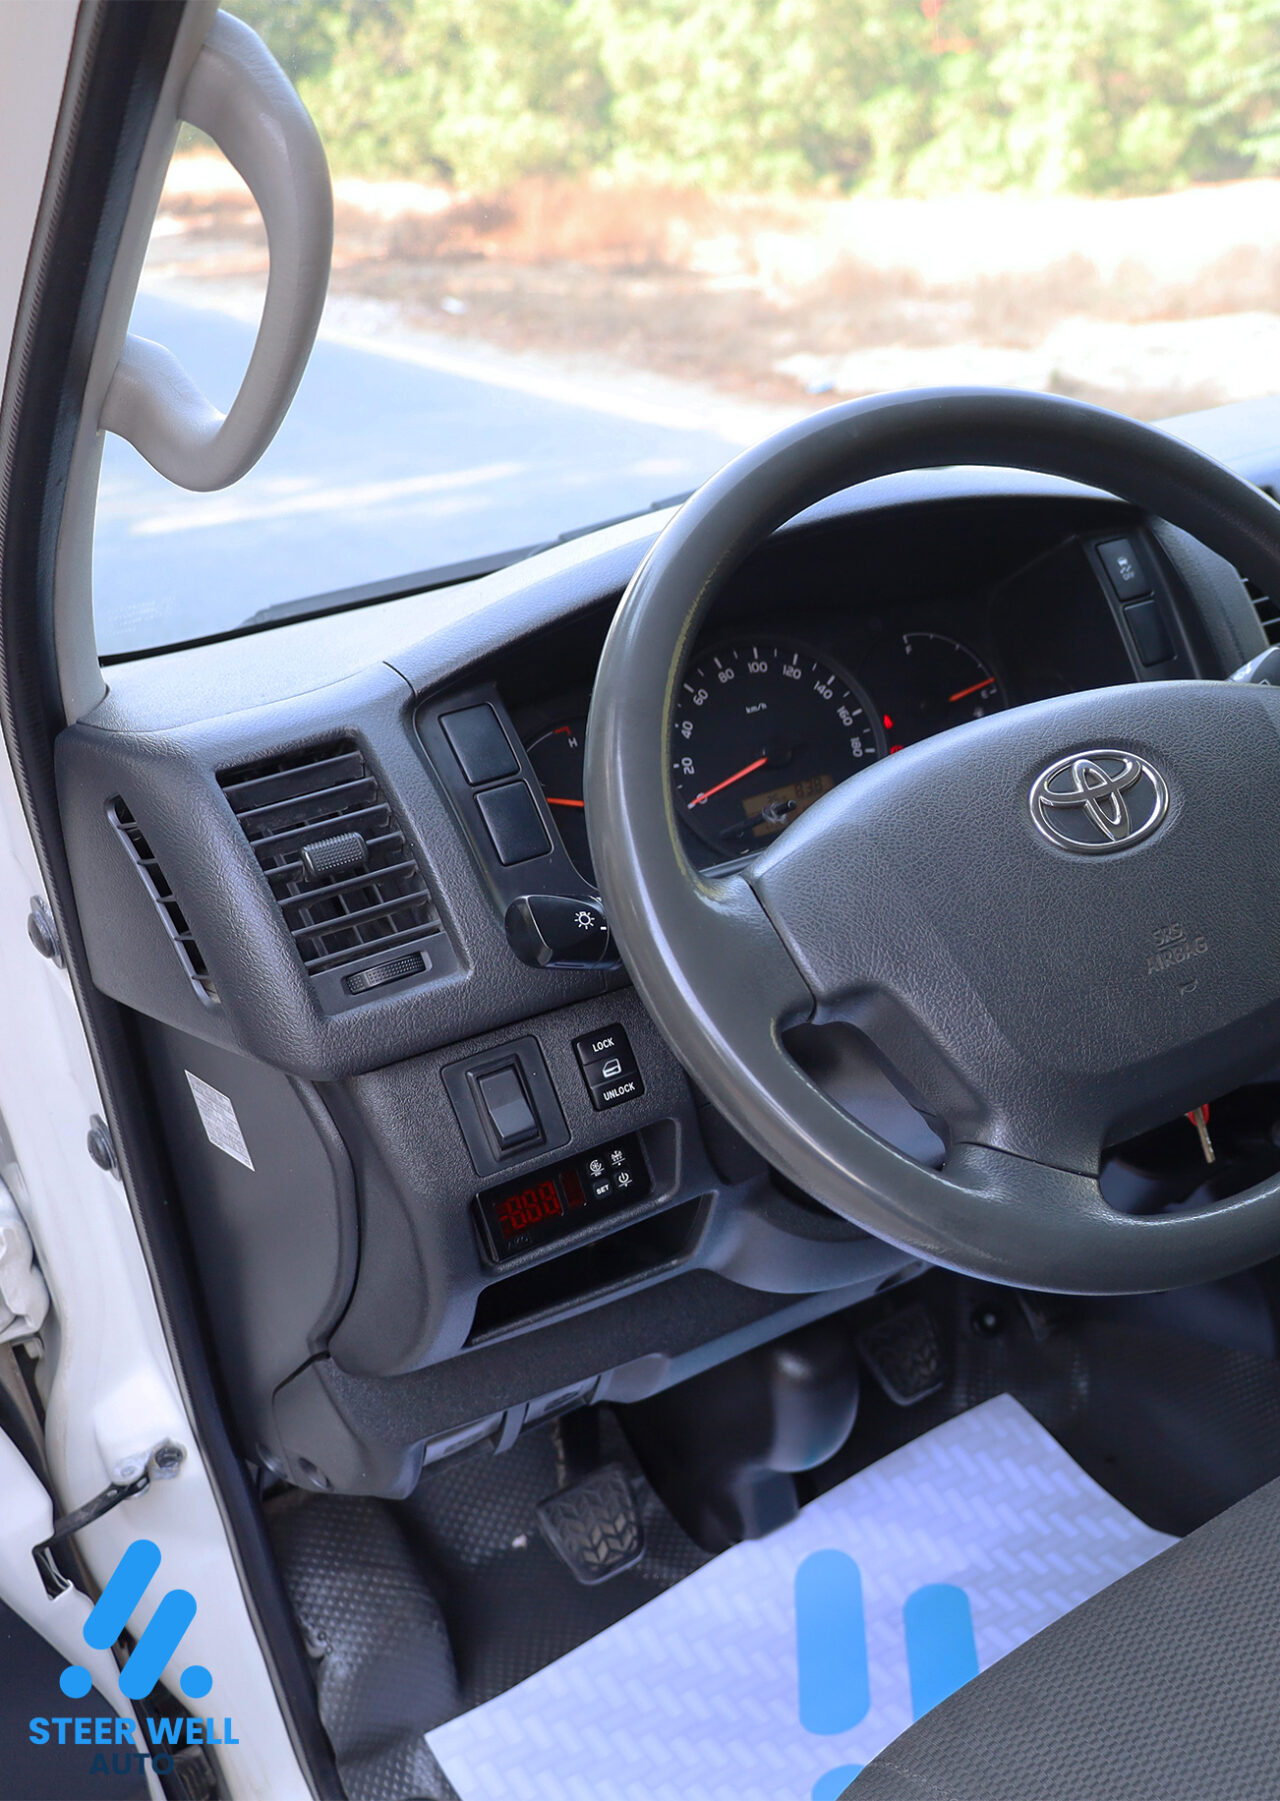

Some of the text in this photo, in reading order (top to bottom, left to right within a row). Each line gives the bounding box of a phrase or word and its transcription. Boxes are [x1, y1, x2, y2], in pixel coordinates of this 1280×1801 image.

[718, 668, 735, 683] 80
[748, 661, 768, 673] 100
[783, 664, 802, 680] 120
[693, 688, 709, 706] 60
[813, 681, 833, 700] 140
[745, 702, 768, 714] km/h
[836, 705, 853, 726] 160
[681, 720, 694, 739] 40
[568, 737, 578, 748] H
[850, 736, 863, 758] 180
[681, 757, 695, 775] 20
[592, 1037, 615, 1053] LOCK
[603, 1082, 636, 1101] UNLOCK
[596, 1183, 610, 1196] SET
